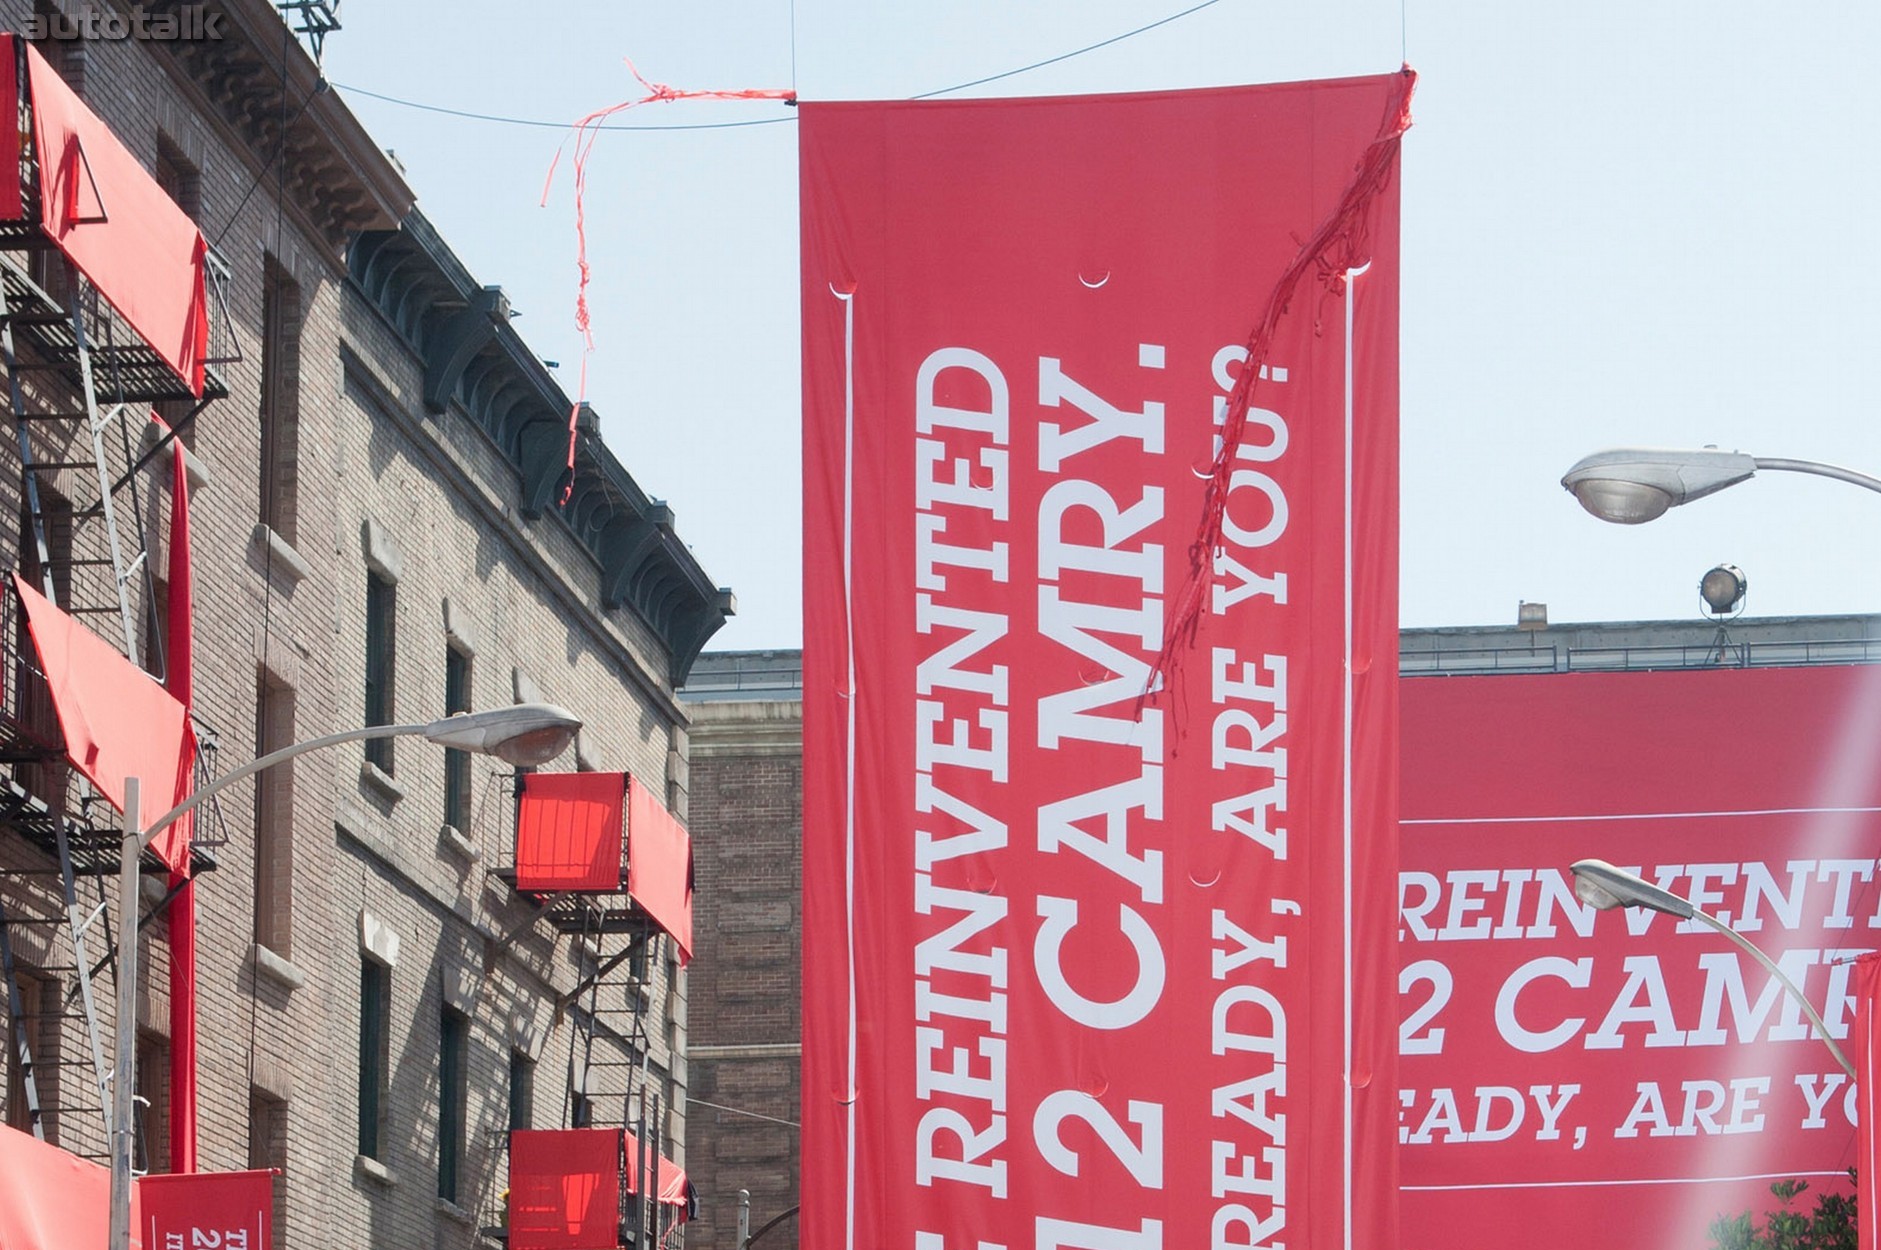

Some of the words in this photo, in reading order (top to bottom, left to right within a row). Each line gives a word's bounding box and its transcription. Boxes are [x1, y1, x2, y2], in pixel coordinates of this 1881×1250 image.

[1211, 345, 1289, 615] YOU?
[915, 347, 1009, 1199] REINVENTED
[1034, 343, 1166, 1029] CAMRY.
[1212, 647, 1287, 860] ARE
[1399, 859, 1881, 942] REINVENT
[1614, 1077, 1771, 1138] ARE
[1795, 1073, 1857, 1129] Y
